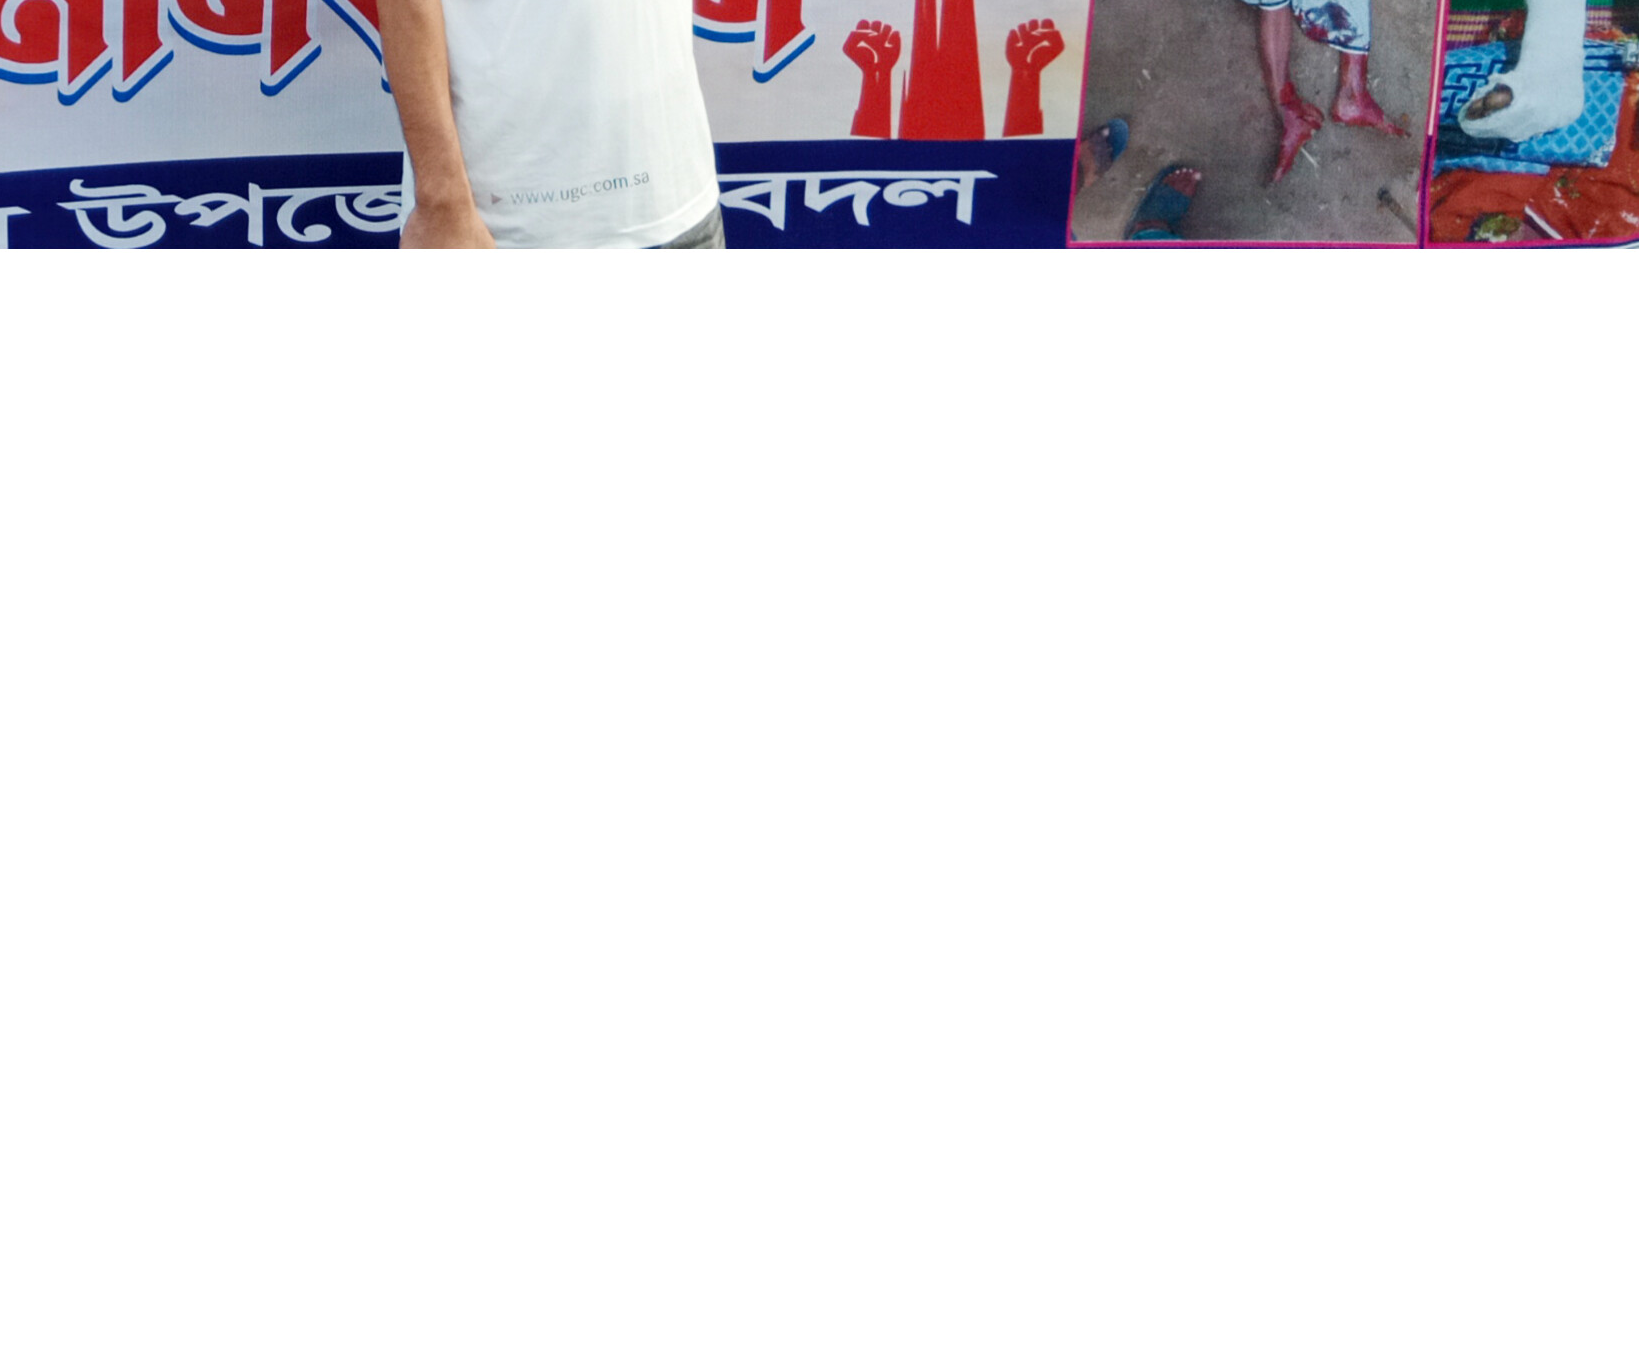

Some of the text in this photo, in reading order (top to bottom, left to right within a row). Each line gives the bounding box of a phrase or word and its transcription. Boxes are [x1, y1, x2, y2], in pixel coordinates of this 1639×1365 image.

[56, 178, 404, 249] উপজে
[717, 170, 999, 231] বদল
[510, 171, 651, 206] www.ugc.com.sa
